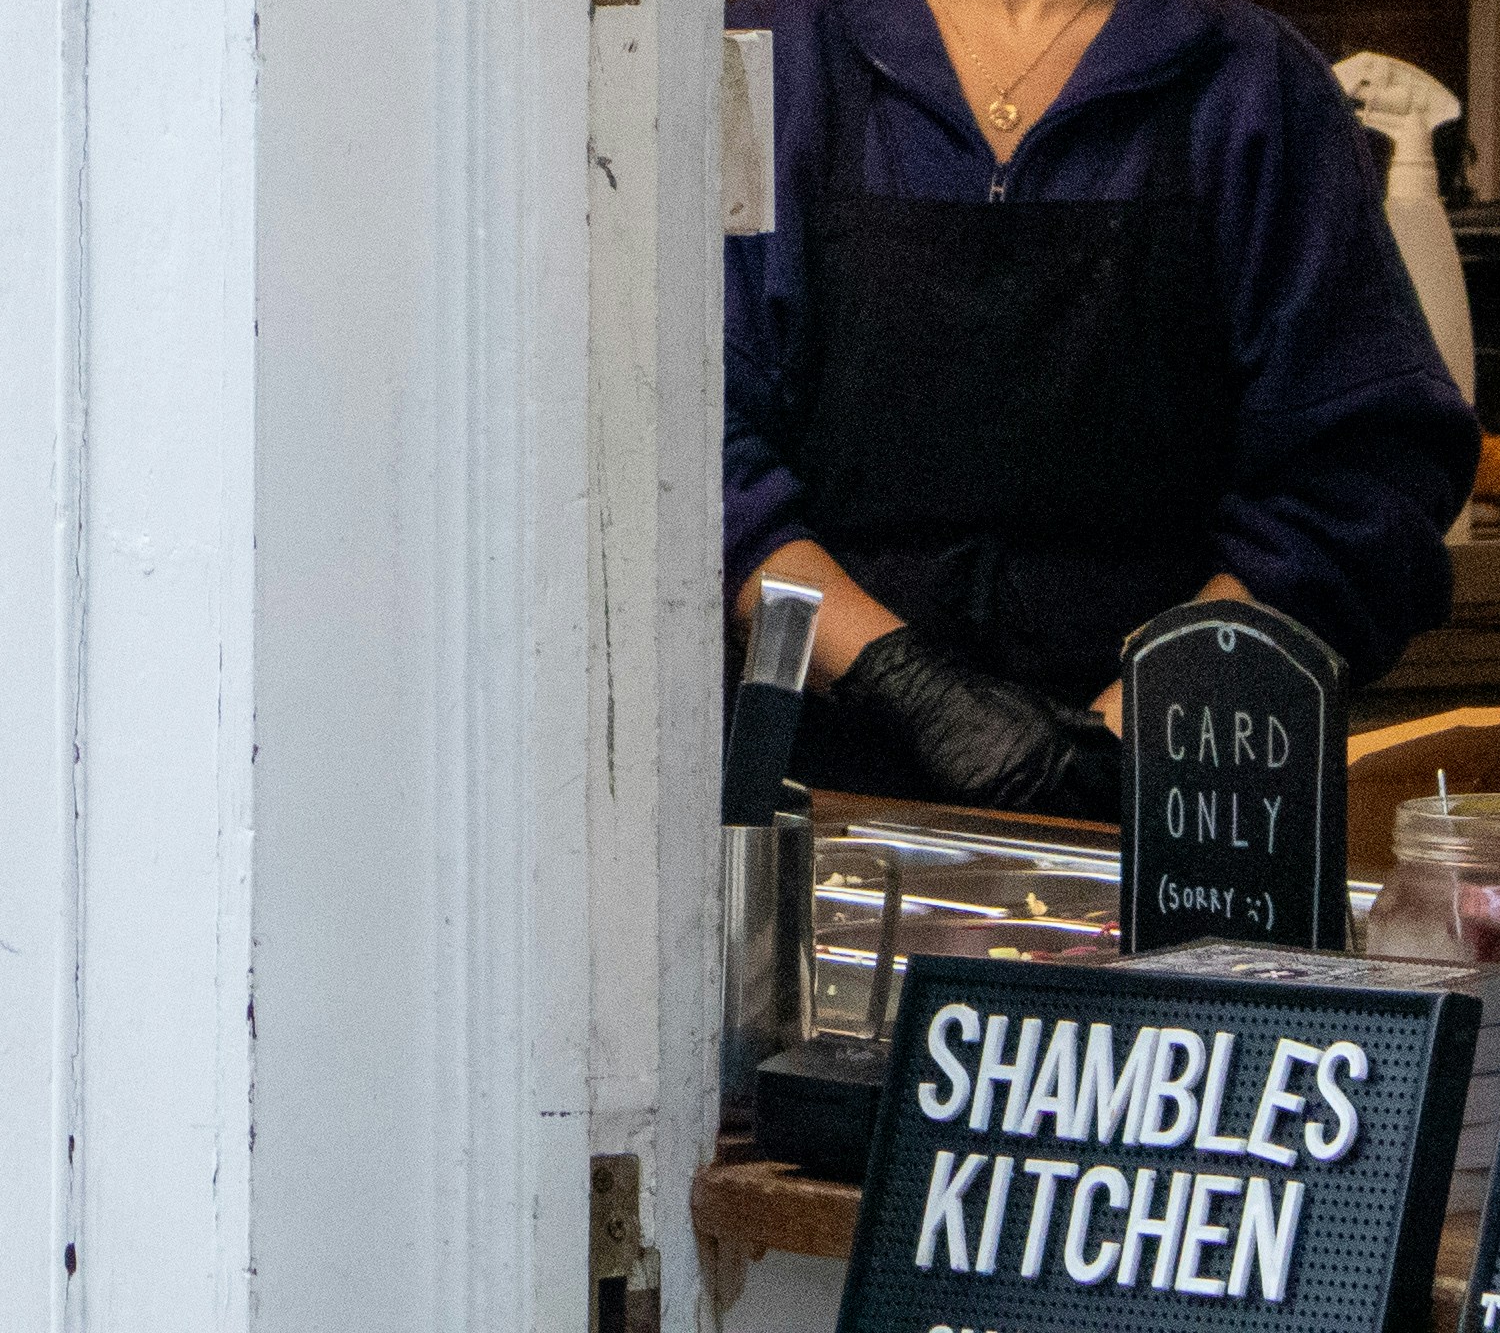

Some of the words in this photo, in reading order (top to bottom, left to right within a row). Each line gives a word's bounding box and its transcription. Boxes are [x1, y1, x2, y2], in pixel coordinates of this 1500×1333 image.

[1166, 703, 1290, 768] CARD
[1166, 786, 1282, 854] ONLY
[918, 1003, 1370, 1168] SHAMBLES
[914, 1150, 1306, 1303] KITCHEN
